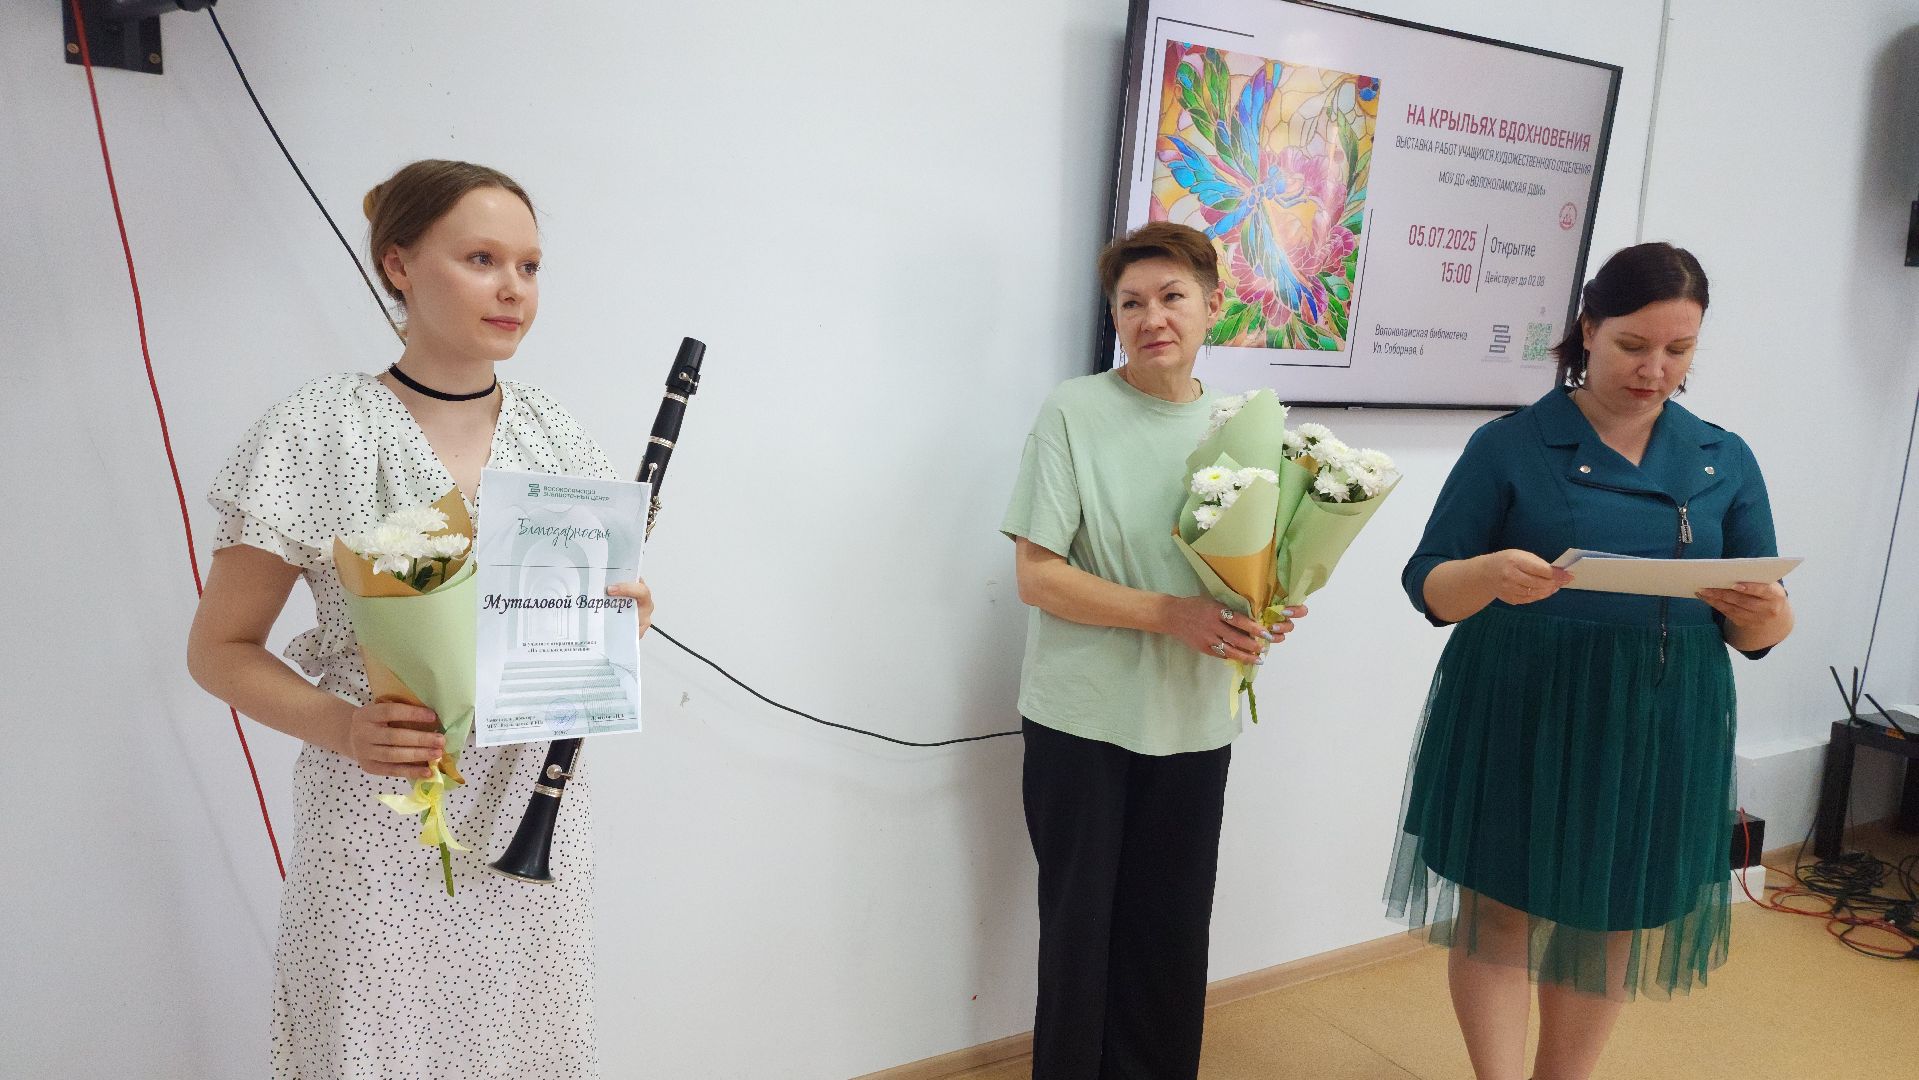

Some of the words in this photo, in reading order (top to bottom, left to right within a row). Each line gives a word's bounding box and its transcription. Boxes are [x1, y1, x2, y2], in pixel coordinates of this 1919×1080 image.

[1406, 104, 1425, 126] НА
[1429, 107, 1497, 137] КРЫЛЬЯХ
[1499, 119, 1591, 153] ВДОХНОВЕНИЯ
[1395, 135, 1433, 153] ВЫСТАВКА
[1434, 140, 1458, 156] РАБОТ
[1458, 144, 1495, 162] УЧАЩИХСЯ
[1494, 150, 1556, 171] ХУДОЖЕСТВЕННОГО
[1555, 159, 1592, 176] ОТДЕЛЕНИЯ
[1438, 171, 1454, 184] МОУ
[1454, 173, 1465, 187] ДО
[1408, 224, 1477, 251] 05.07.2025
[1490, 236, 1536, 258] Открытие
[1441, 261, 1472, 284] 15:00
[1485, 270, 1519, 287] Действует
[1518, 276, 1527, 287] до
[1375, 323, 1428, 338] Волоколамская
[1429, 327, 1468, 341] библиотека
[1372, 340, 1383, 354] Ул.
[518, 518, 611, 549] Благодарность
[483, 593, 573, 615] Муталовой
[576, 594, 633, 614] Варваре
